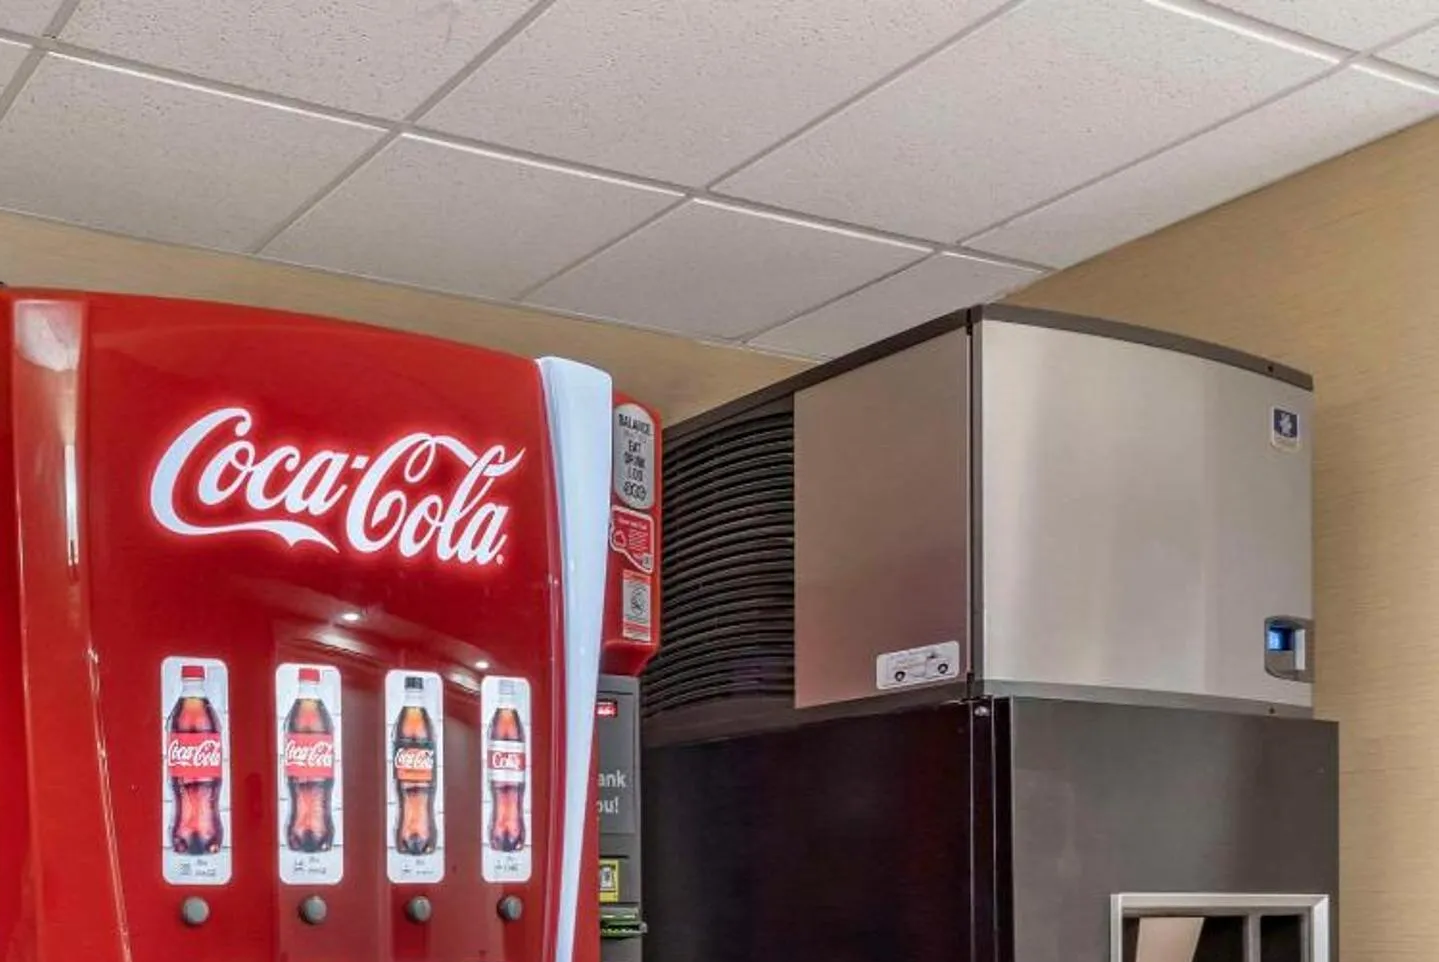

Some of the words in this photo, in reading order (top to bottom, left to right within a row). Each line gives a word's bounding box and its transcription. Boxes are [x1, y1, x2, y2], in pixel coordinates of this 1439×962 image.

[150, 406, 527, 566] Coca-Cola
[167, 738, 221, 769] Coca-Cola
[285, 738, 333, 769] Coca-Cola
[598, 771, 627, 789] ank
[597, 797, 620, 814] ou!
